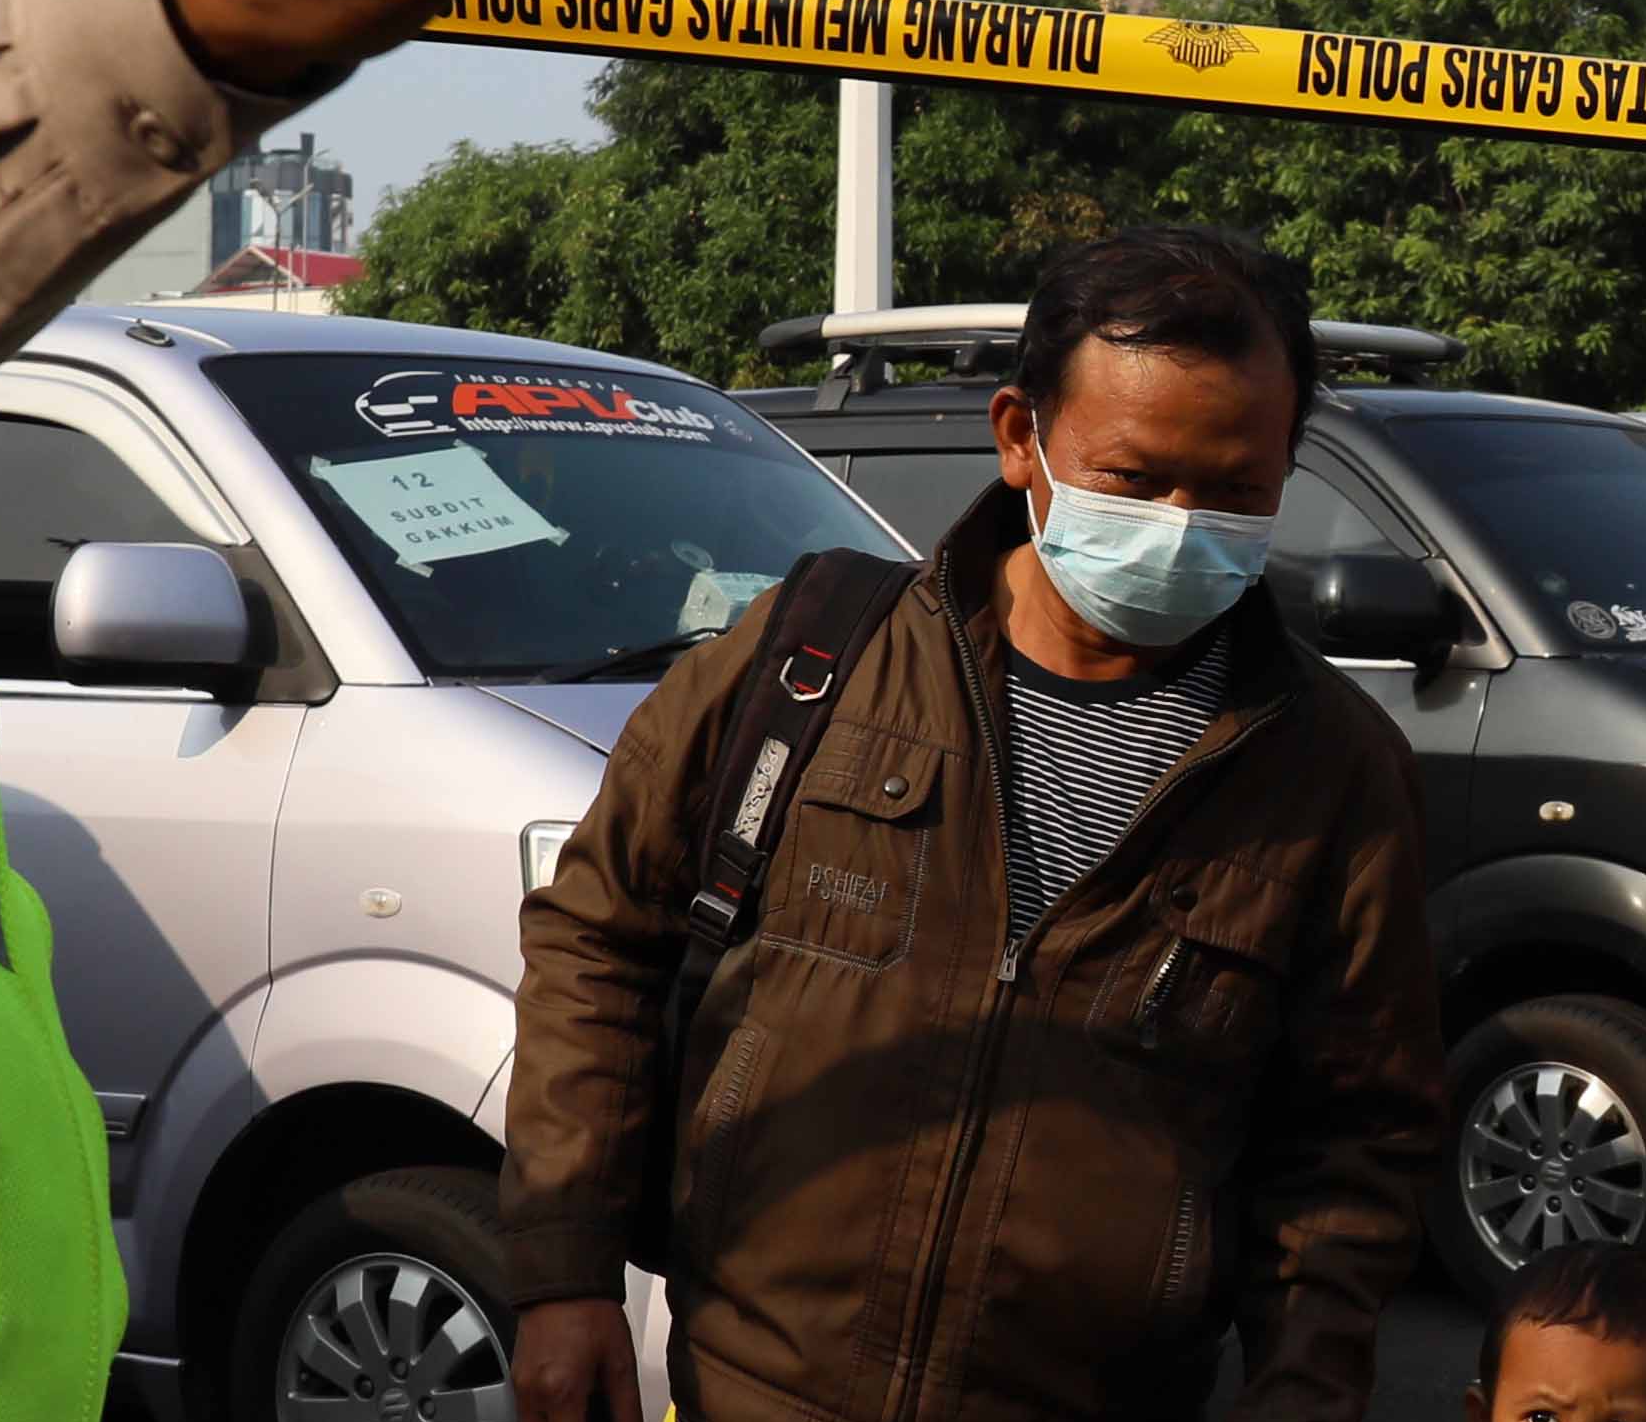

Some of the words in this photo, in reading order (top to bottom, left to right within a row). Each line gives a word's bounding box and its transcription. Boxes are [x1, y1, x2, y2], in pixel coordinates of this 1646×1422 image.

[1297, 33, 1431, 105] POLISI
[1441, 47, 1565, 118] GARIS
[454, 374, 626, 392] INDONESIA
[457, 416, 711, 443] http://www.apvclub.com
[391, 471, 435, 491] 12
[390, 497, 485, 523] SUBDIT
[405, 515, 514, 544] GAKKUM
